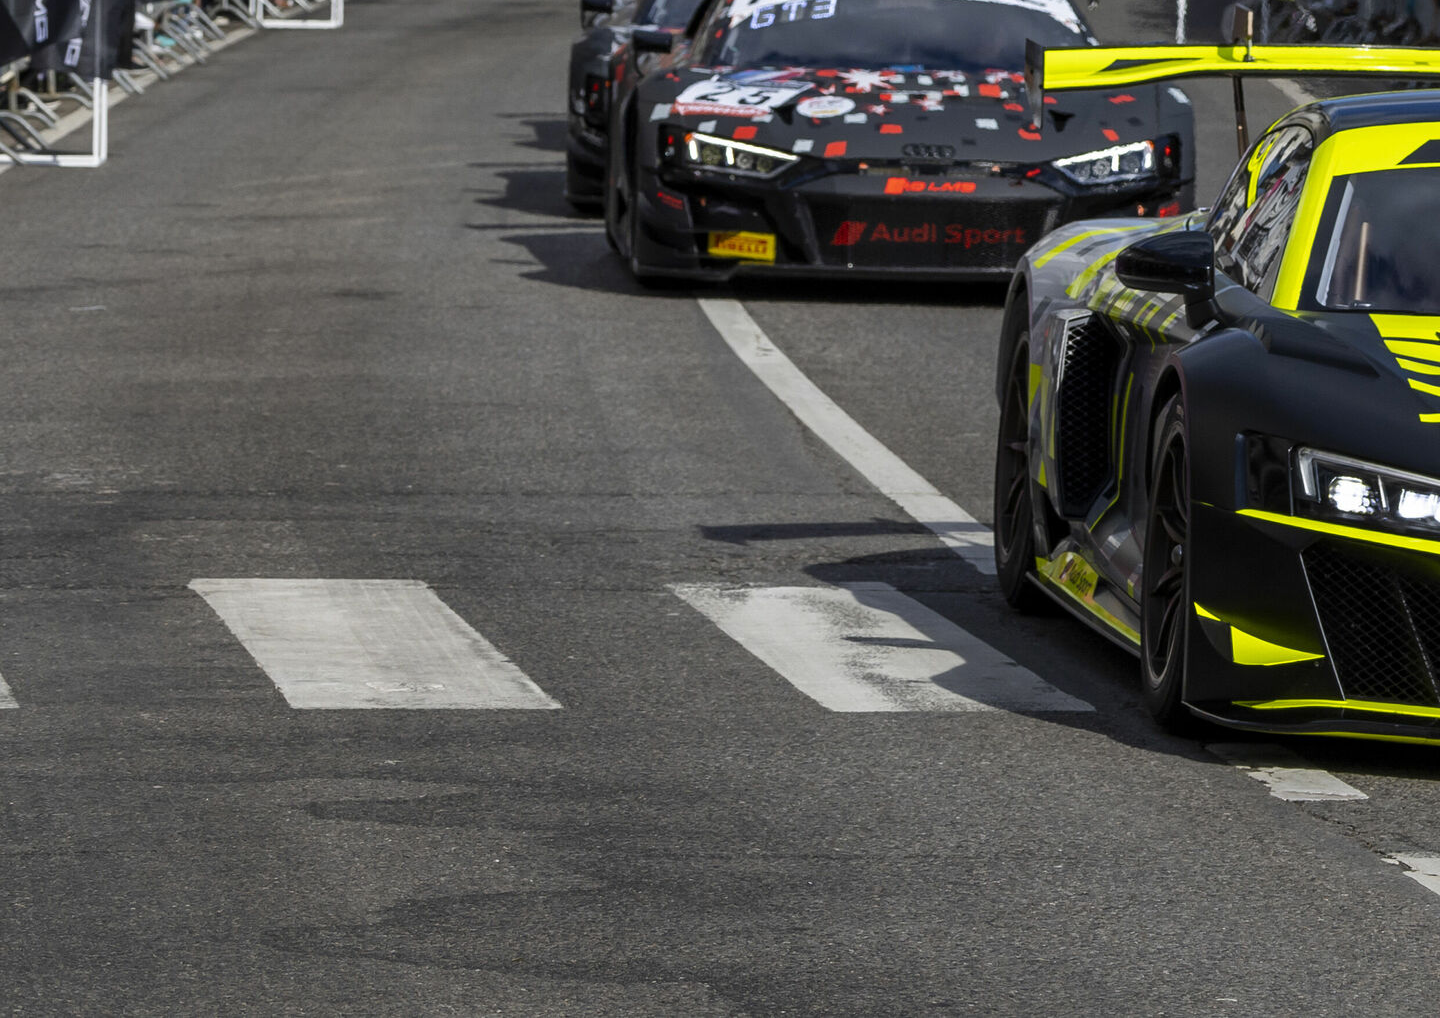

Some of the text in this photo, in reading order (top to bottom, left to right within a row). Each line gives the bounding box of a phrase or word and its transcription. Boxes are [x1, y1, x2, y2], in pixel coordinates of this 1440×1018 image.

[695, 85, 774, 105] 25
[869, 222, 1027, 249] Audi Sport
